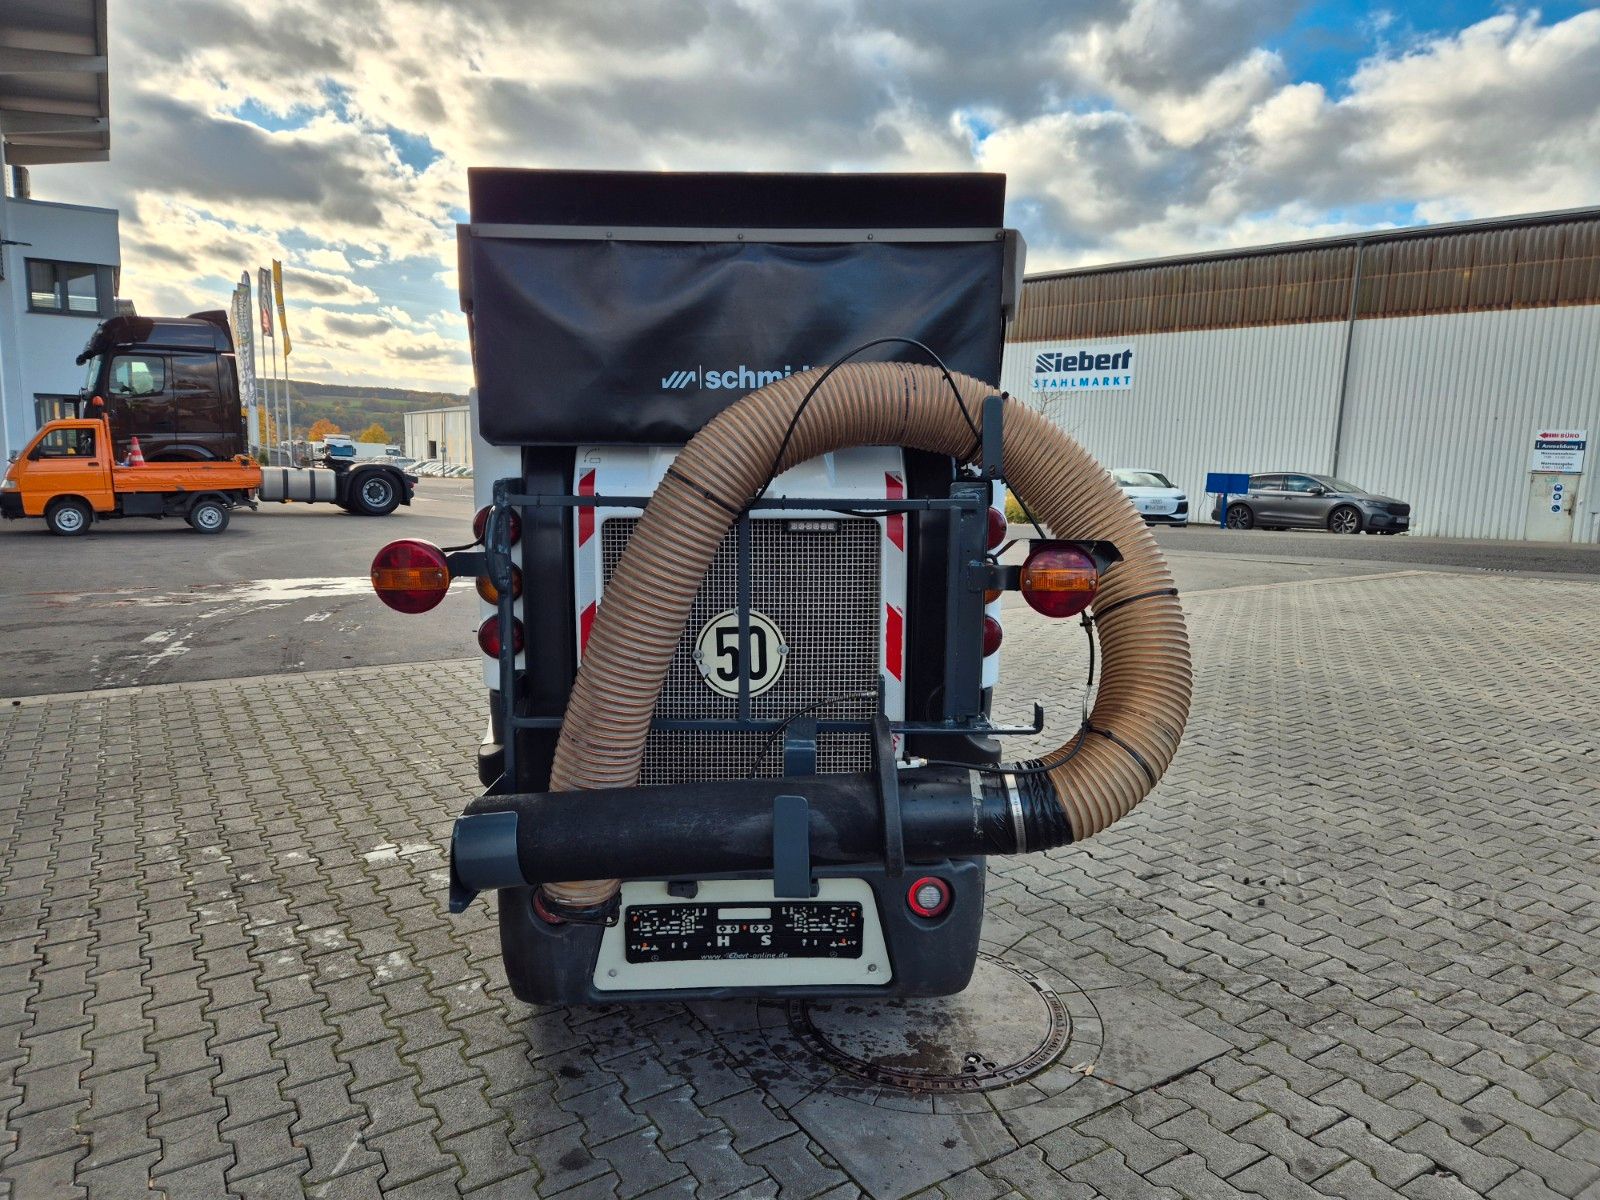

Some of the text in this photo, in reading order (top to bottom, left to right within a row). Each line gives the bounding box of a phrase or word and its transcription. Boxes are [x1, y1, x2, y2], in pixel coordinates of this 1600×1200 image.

[1035, 349, 1133, 373] Siebert
[705, 364, 815, 390] schm
[1034, 376, 1131, 388] STAHLMARKT
[715, 625, 768, 682] 50
